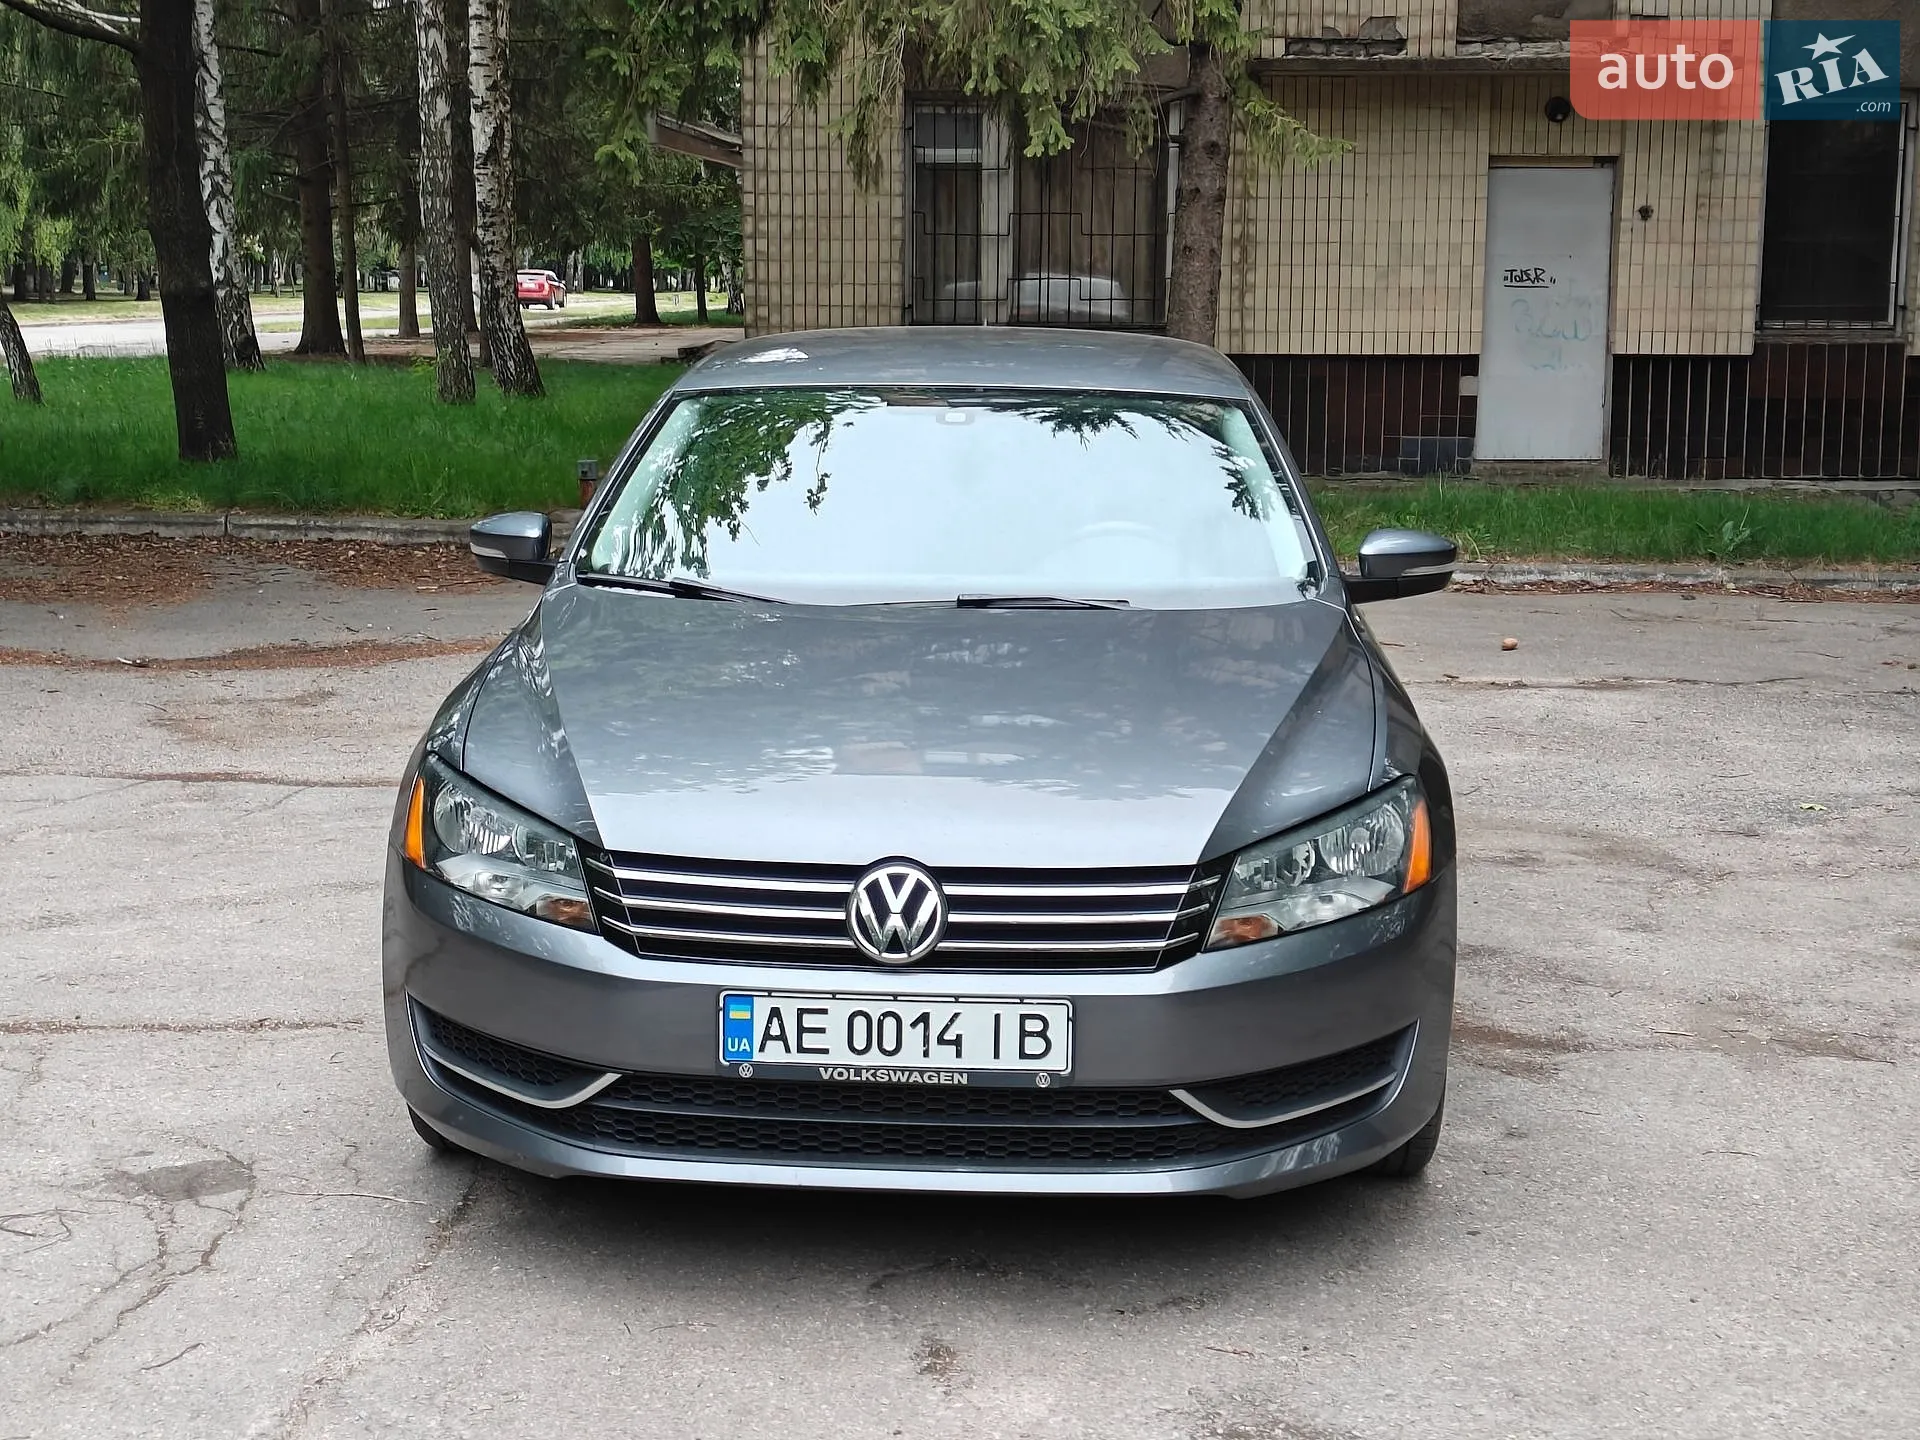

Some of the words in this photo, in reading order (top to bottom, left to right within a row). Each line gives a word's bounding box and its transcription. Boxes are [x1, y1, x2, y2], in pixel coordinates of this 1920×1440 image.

[758, 1008, 830, 1054] AE
[846, 1009, 963, 1058] 0014
[993, 1012, 1053, 1060] IB
[727, 1037, 751, 1052] UA
[819, 1066, 968, 1085] VOLKSWAGEN
